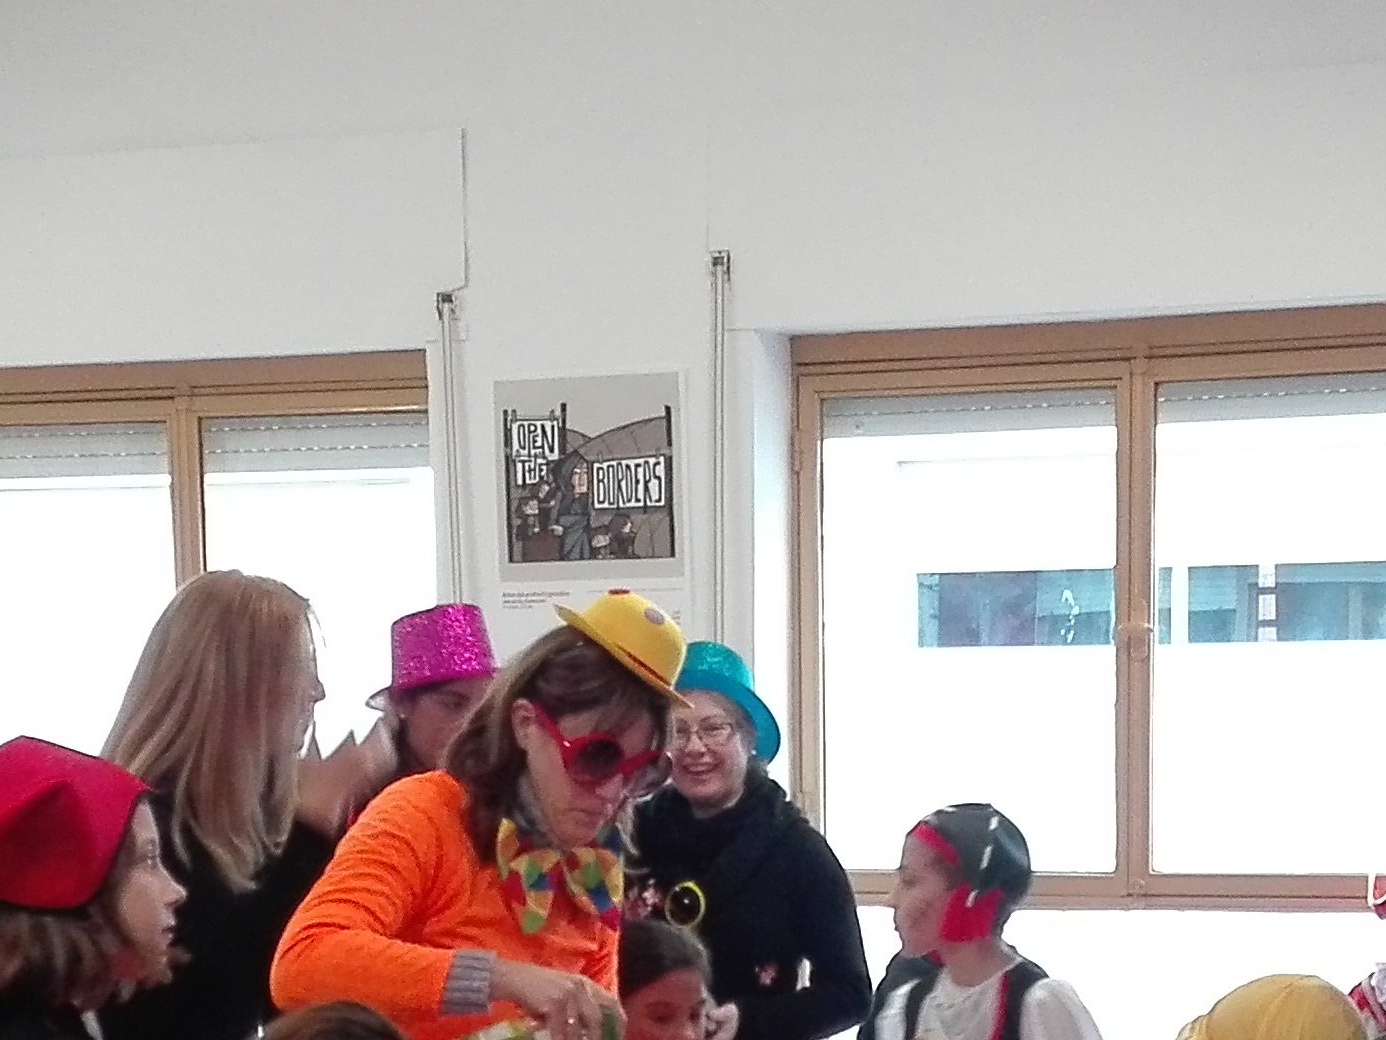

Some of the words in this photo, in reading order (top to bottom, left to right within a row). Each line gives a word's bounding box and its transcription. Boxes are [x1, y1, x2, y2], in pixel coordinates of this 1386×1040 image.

[517, 422, 556, 457] OPEN
[517, 455, 548, 485] THE
[595, 460, 663, 508] BORDERS
